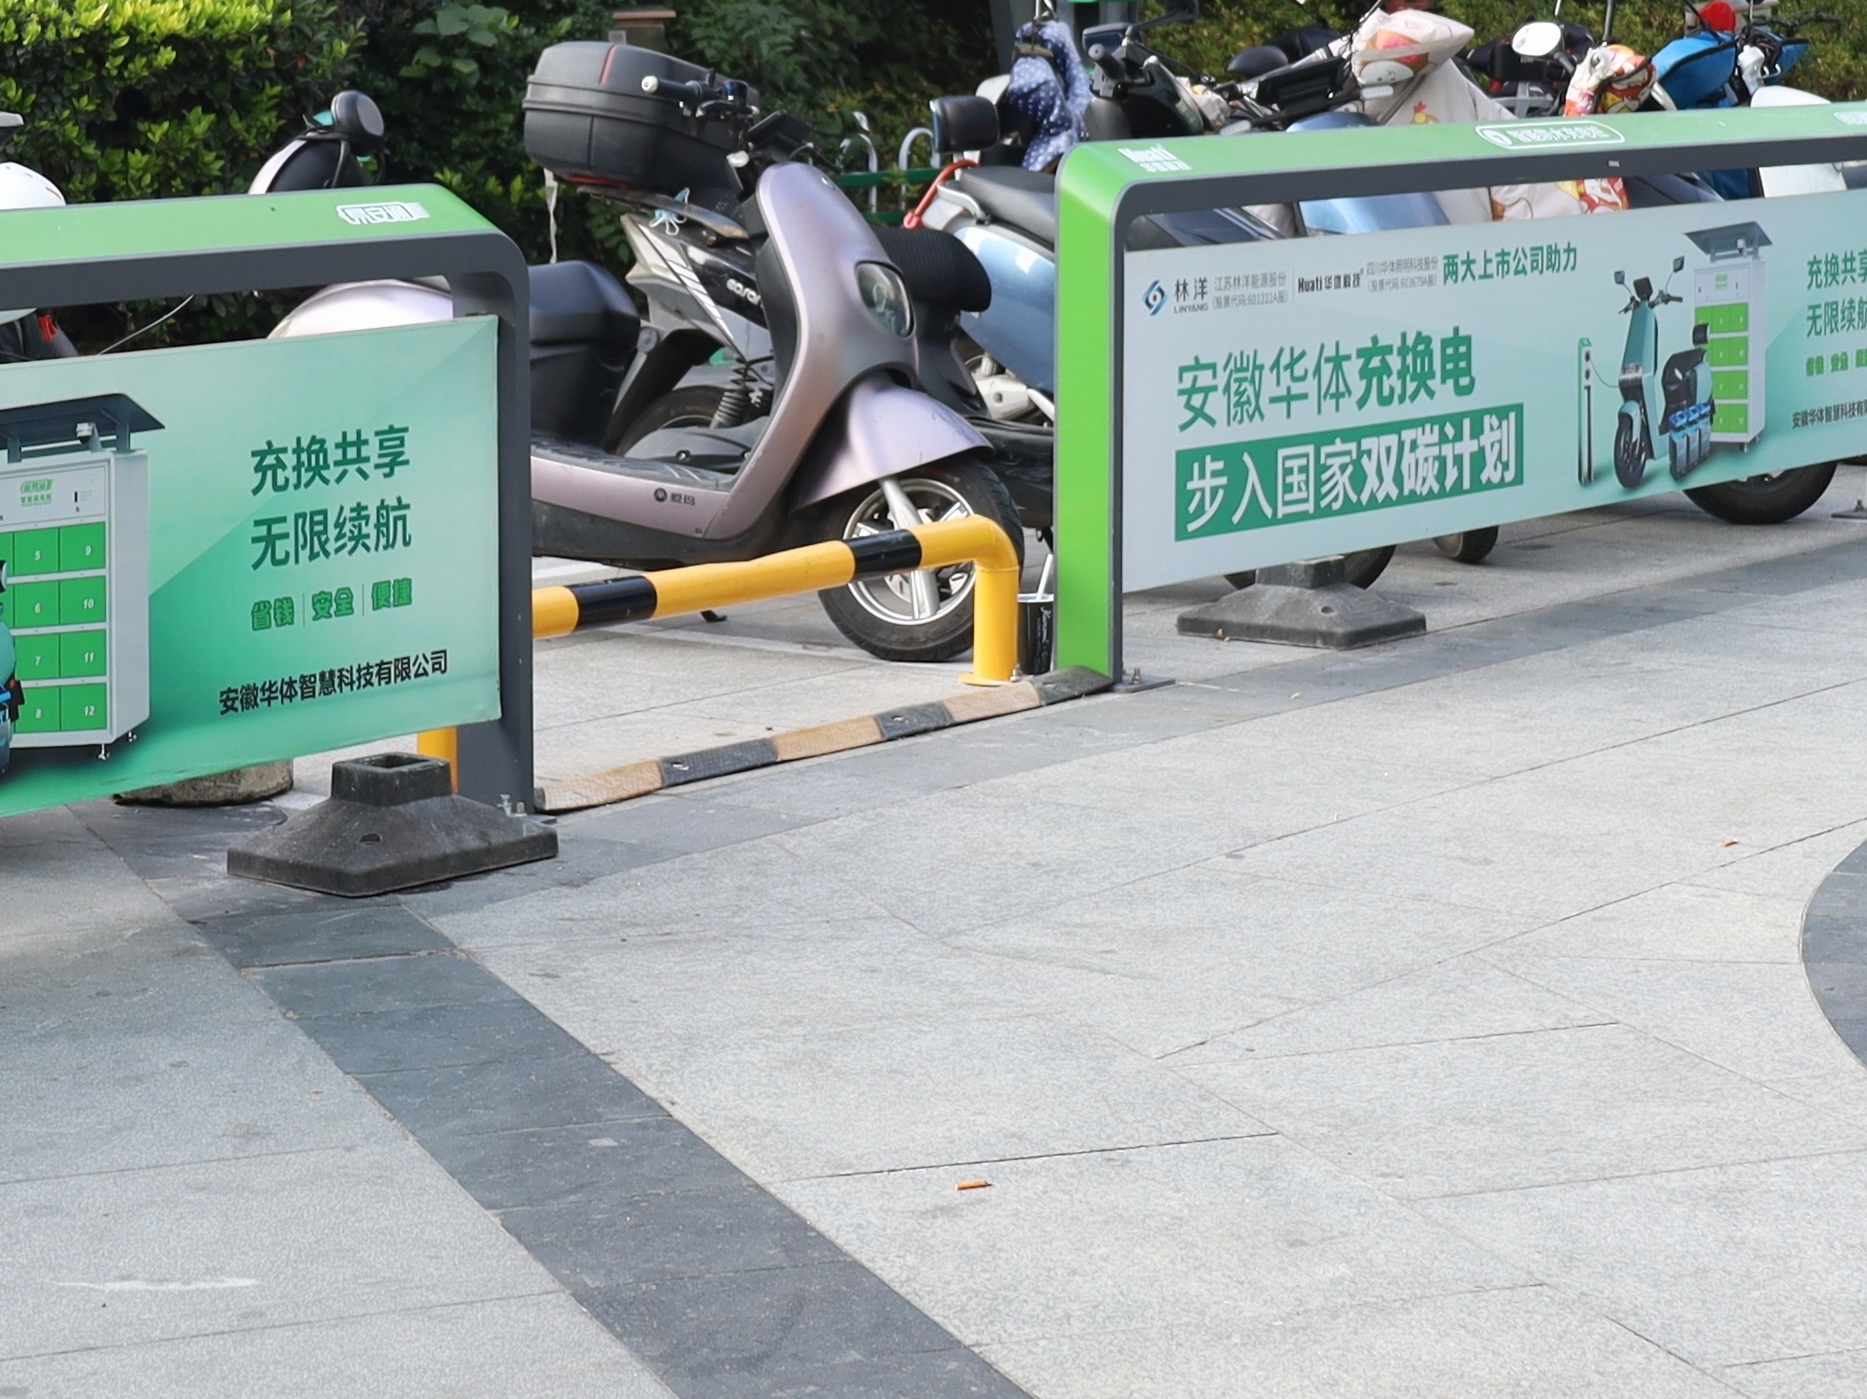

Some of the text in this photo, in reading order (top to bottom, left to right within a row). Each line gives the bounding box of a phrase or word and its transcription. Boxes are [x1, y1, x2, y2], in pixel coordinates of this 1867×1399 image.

[1174, 277, 1209, 300] 林洋
[1442, 242, 1578, 286] 两大上市公司助力
[1176, 325, 1476, 433] 安徽华体充换电
[250, 425, 411, 497] 充换共享
[1185, 410, 1517, 534] 步入国家双碳计划
[34, 549, 41, 562] 5
[85, 545, 92, 558] 9
[250, 495, 412, 571] 无限续航
[82, 598, 95, 610] 10
[250, 577, 413, 631] 省钱 安全 便捷
[35, 651, 95, 667] 7 11
[218, 649, 449, 716] 安徽华体智慧科技有限公司
[84, 704, 96, 716] 12
